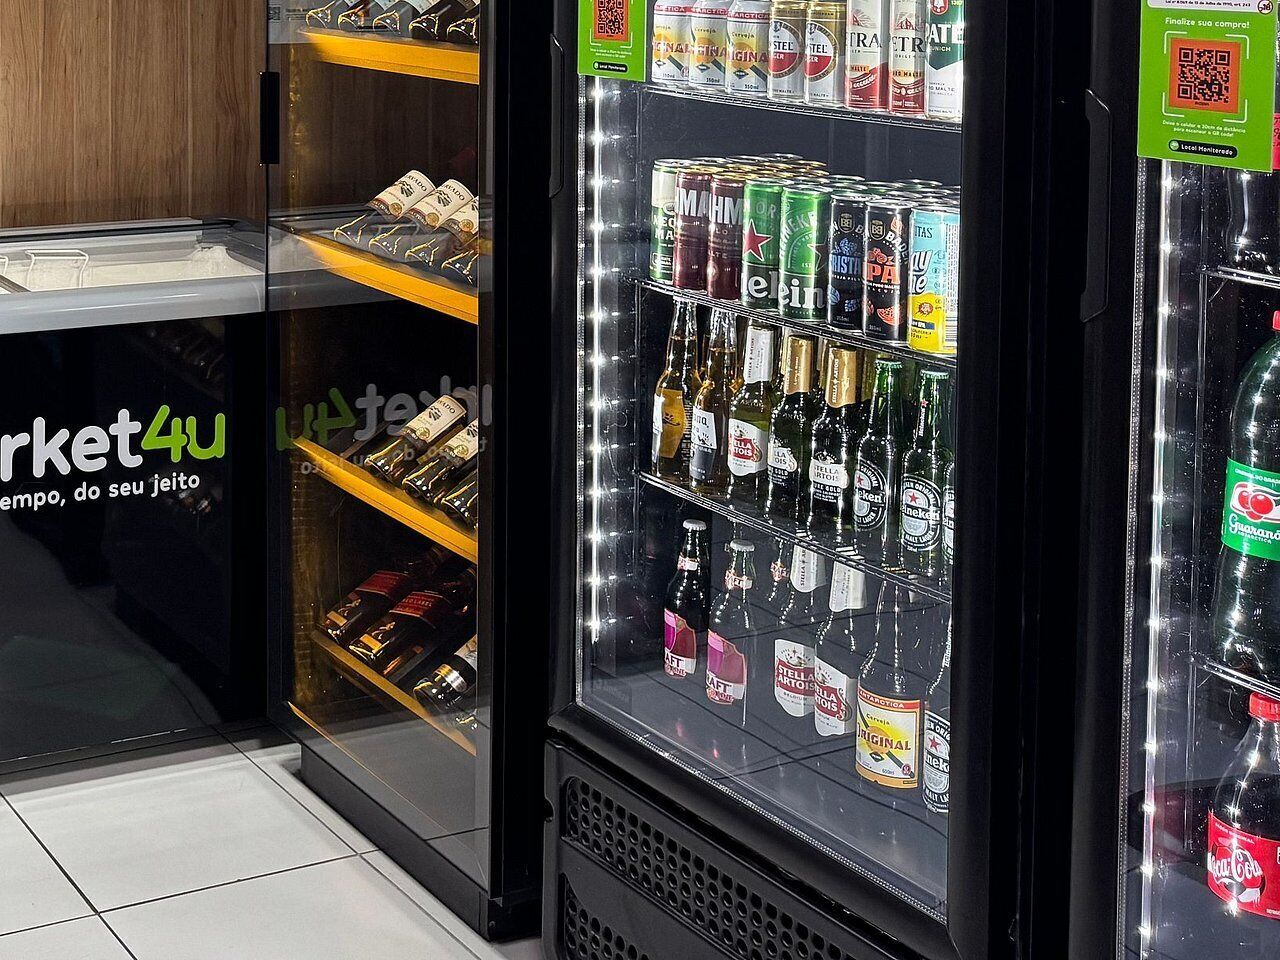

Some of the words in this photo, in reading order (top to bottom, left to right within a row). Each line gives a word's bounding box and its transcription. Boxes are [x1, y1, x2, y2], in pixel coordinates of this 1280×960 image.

[1165, 17, 1195, 26] Finalize
[1215, 21, 1250, 29] compra!
[773, 41, 793, 50] STEL
[846, 32, 882, 48] TRA
[891, 36, 925, 53] ETR
[1199, 146, 1233, 156] Monitorado
[867, 263, 900, 284] PA
[733, 440, 752, 450] ELLA
[733, 447, 753, 456] TOIS
[73, 482, 101, 502] do
[108, 478, 144, 498] seu
[150, 472, 200, 498] jeito
[902, 505, 940, 521] eineken
[778, 665, 814, 681] STELLA
[778, 674, 815, 690] ARTOIS
[816, 688, 837, 702] ELLA
[866, 713, 890, 726] Cerveja
